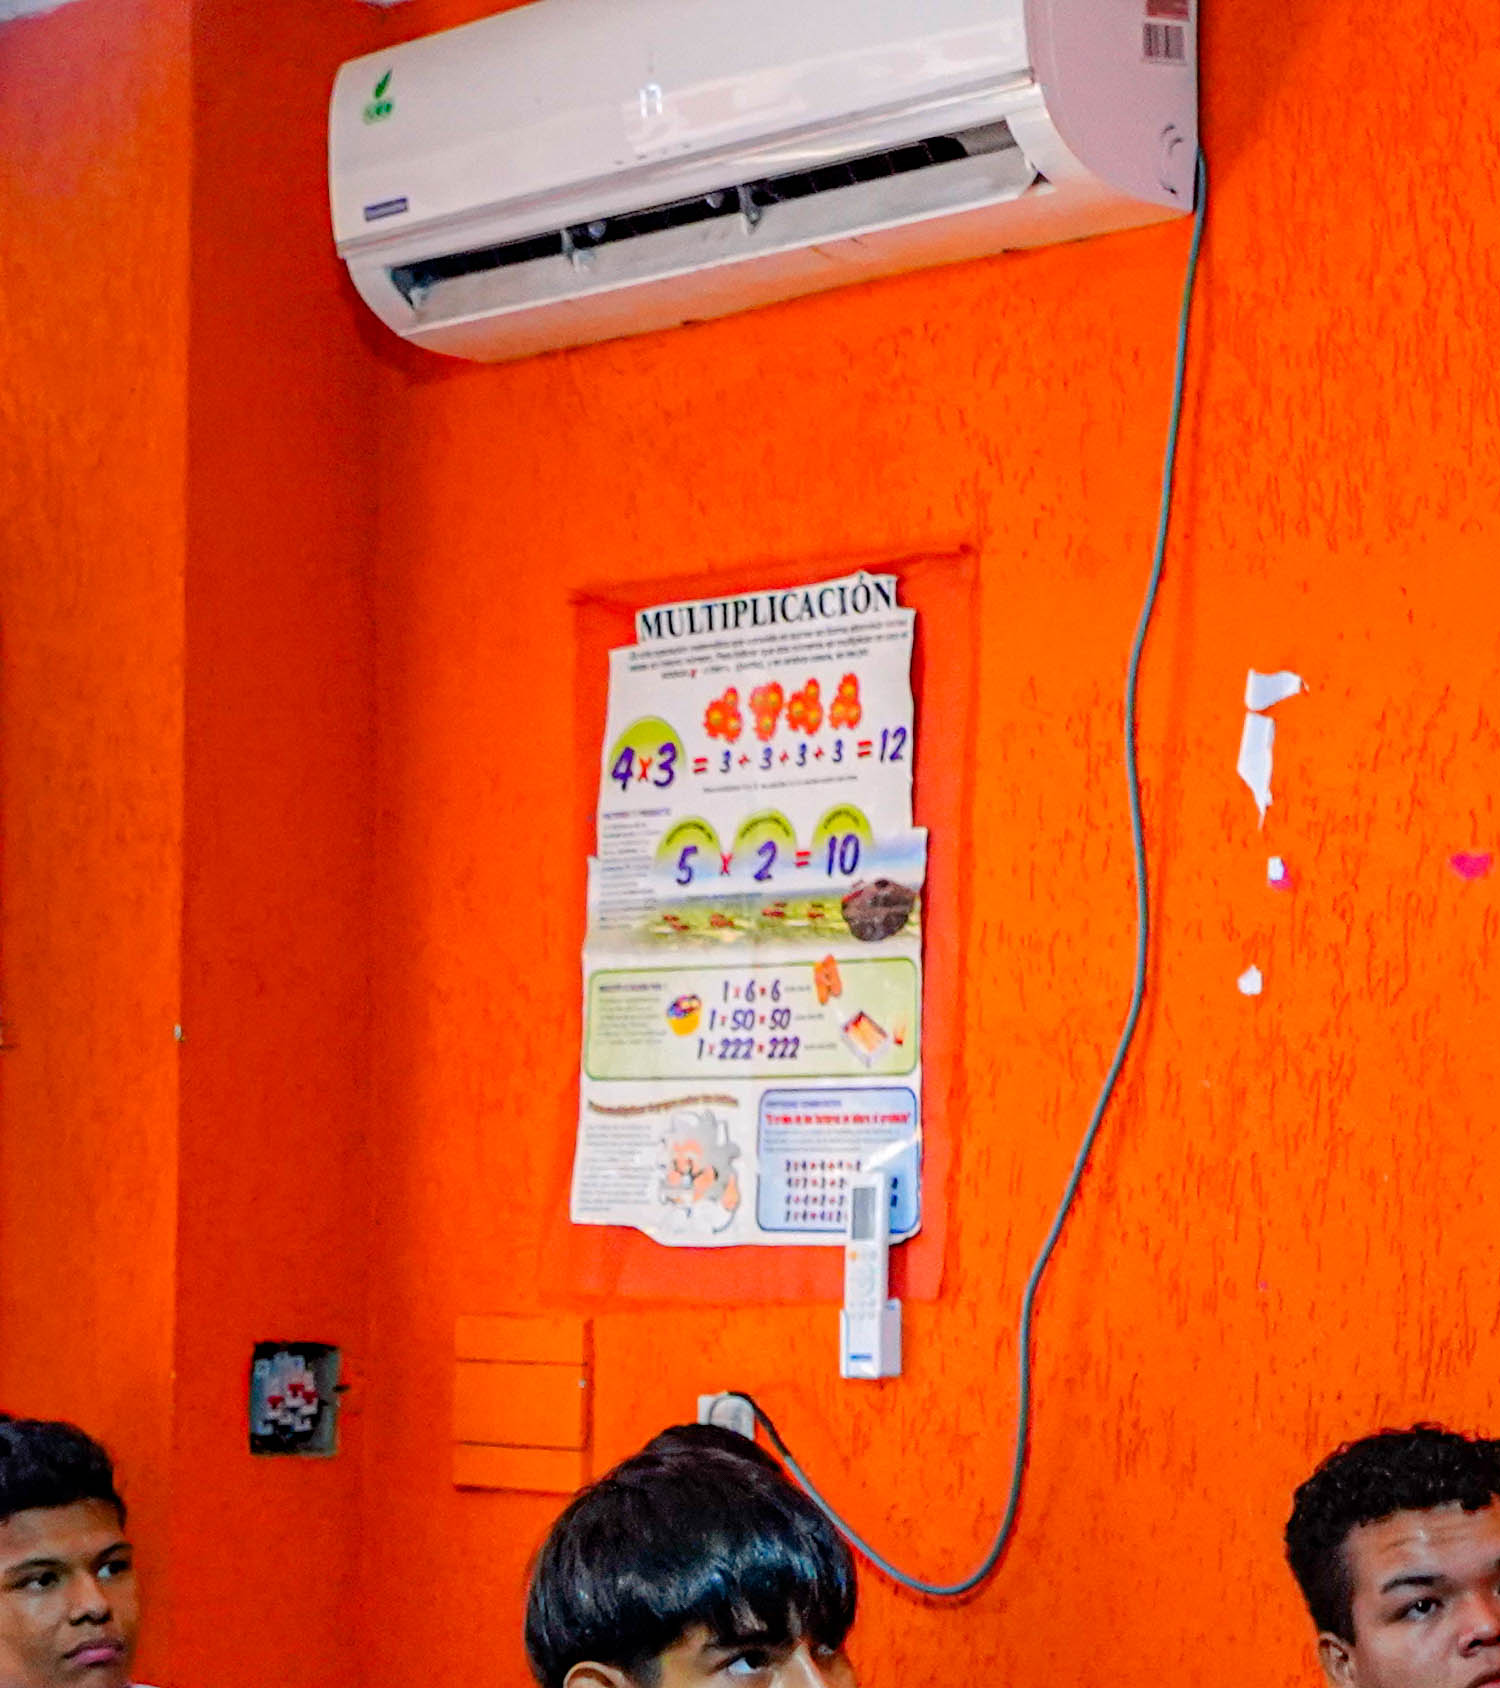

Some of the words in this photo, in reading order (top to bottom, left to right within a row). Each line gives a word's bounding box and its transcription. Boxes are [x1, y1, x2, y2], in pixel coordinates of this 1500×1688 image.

[640, 576, 897, 641] MULTIPLICACIÓN
[719, 749, 732, 774] 3
[760, 746, 773, 771] 3
[797, 742, 807, 768] 3
[832, 738, 843, 764] 3
[879, 726, 907, 763] 12
[676, 845, 698, 885] 5
[753, 840, 777, 882] 2
[825, 834, 860, 877] 10
